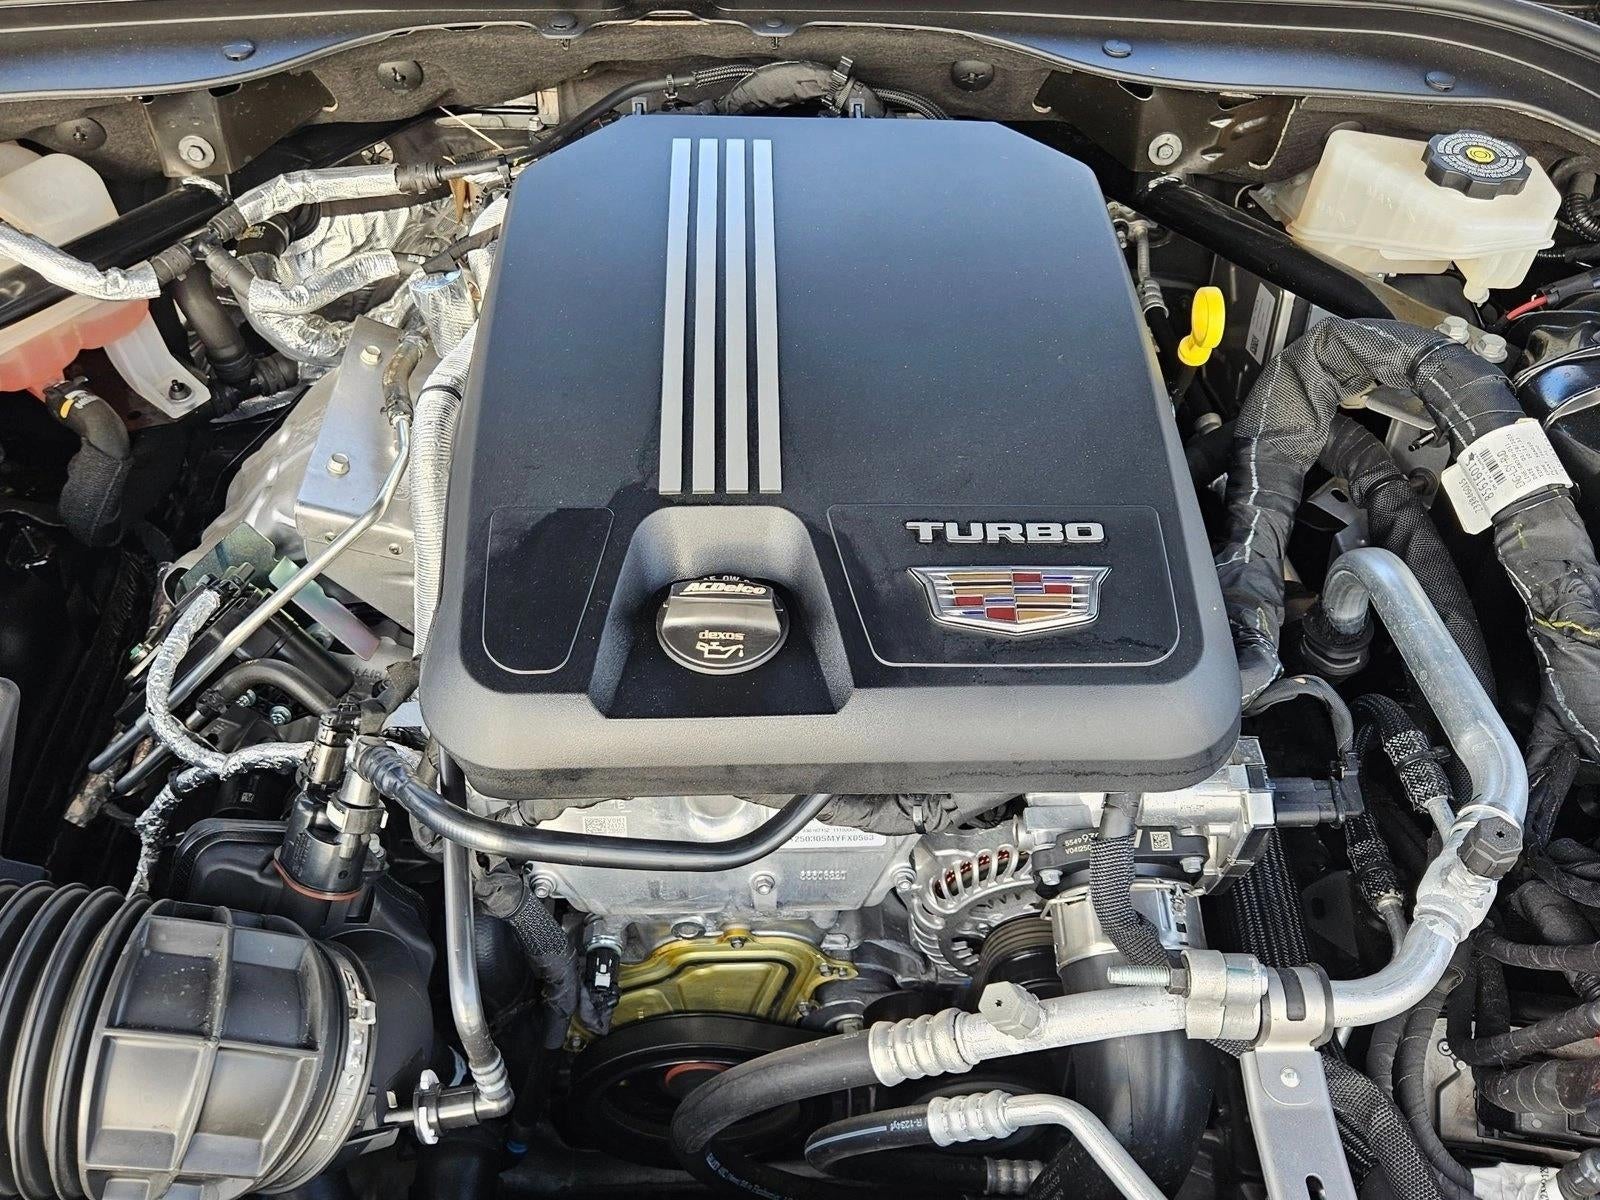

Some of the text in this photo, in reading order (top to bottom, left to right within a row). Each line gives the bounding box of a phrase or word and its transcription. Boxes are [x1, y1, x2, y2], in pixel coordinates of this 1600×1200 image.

[906, 522, 1104, 543] TURBO
[683, 582, 767, 595] ACDelco
[698, 630, 745, 641] dexos
